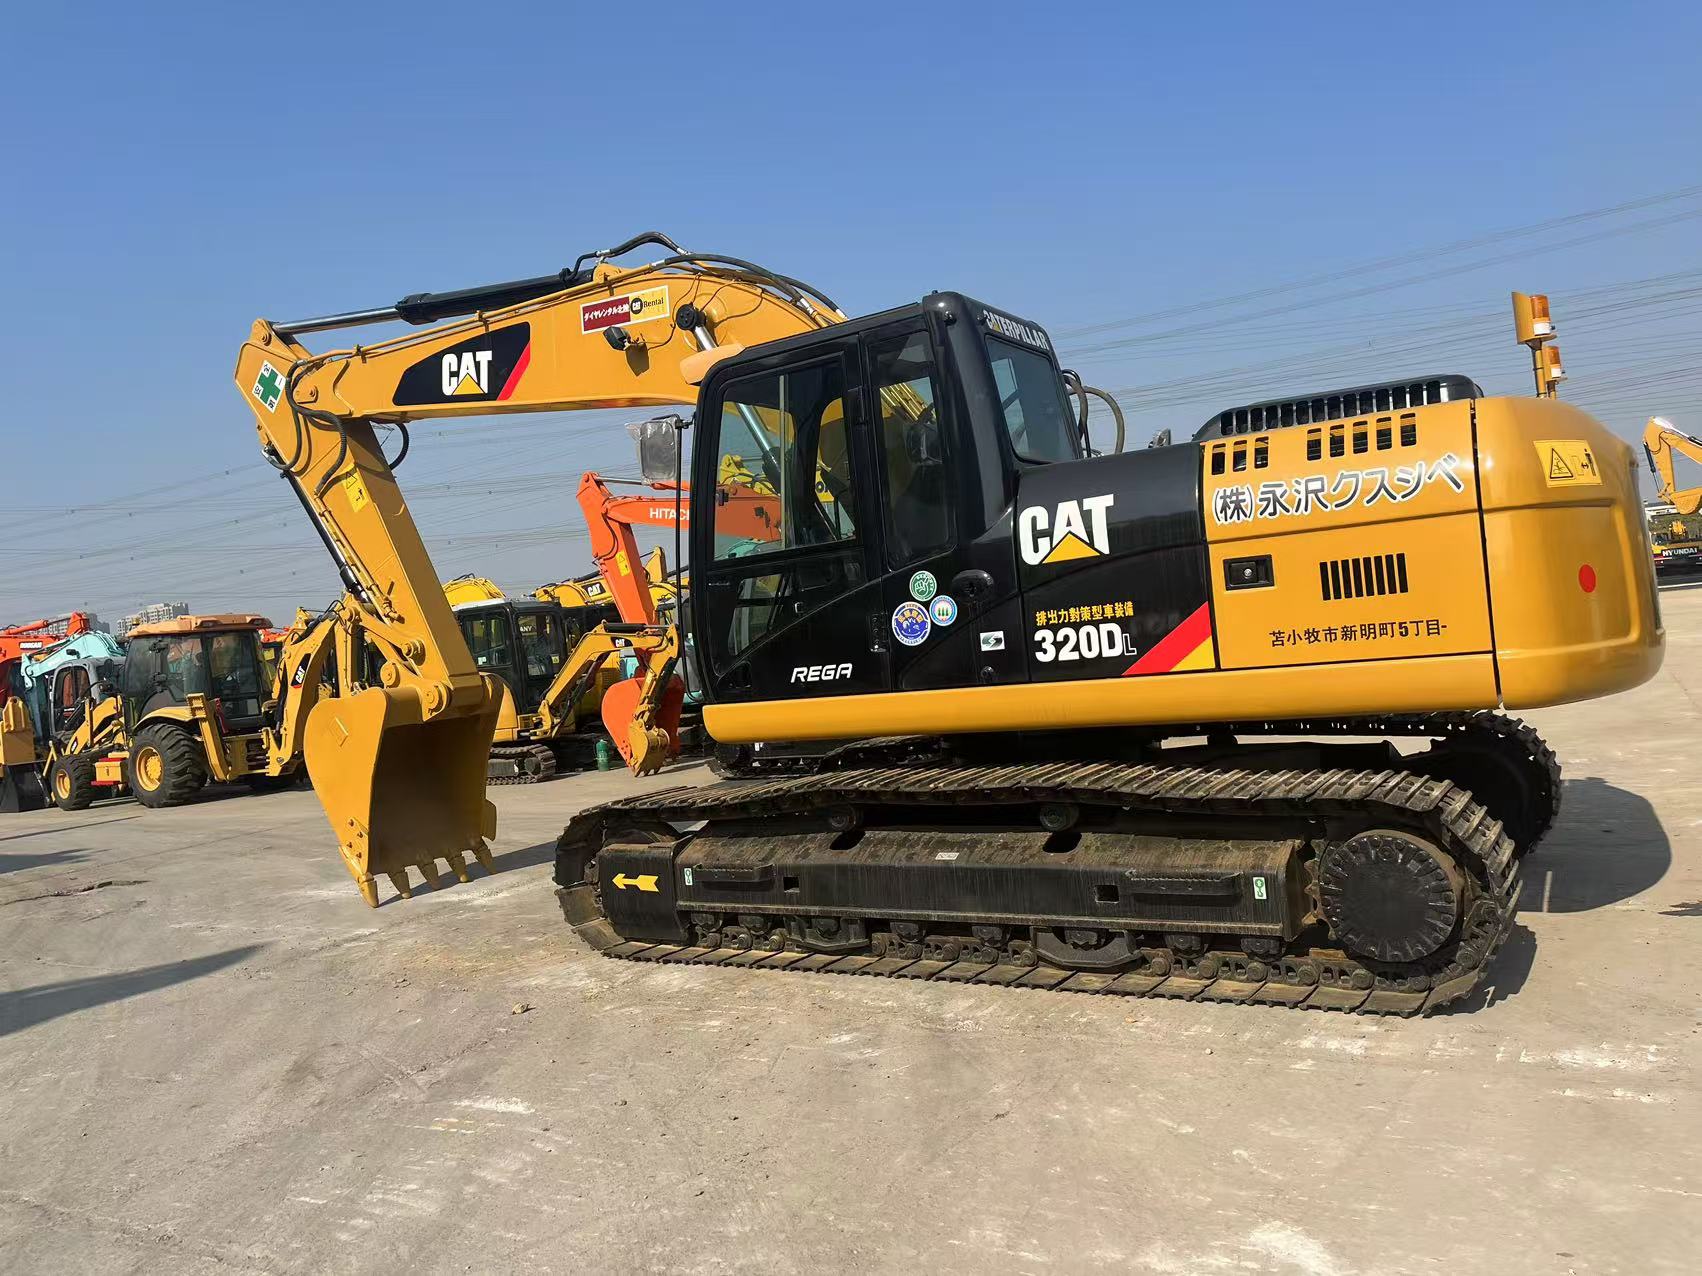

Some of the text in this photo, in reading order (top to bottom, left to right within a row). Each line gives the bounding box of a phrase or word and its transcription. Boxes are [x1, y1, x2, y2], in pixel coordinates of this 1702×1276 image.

[643, 297, 664, 308] Rental
[983, 309, 1049, 351] CATERPILLAR
[441, 350, 493, 396] CAT
[1019, 493, 1114, 566] CAT
[1662, 548, 1697, 556] HYUNDAI
[587, 583, 601, 597] CAT
[615, 638, 625, 648] CAT
[295, 665, 306, 684] CAT
[790, 662, 853, 684] REGA
